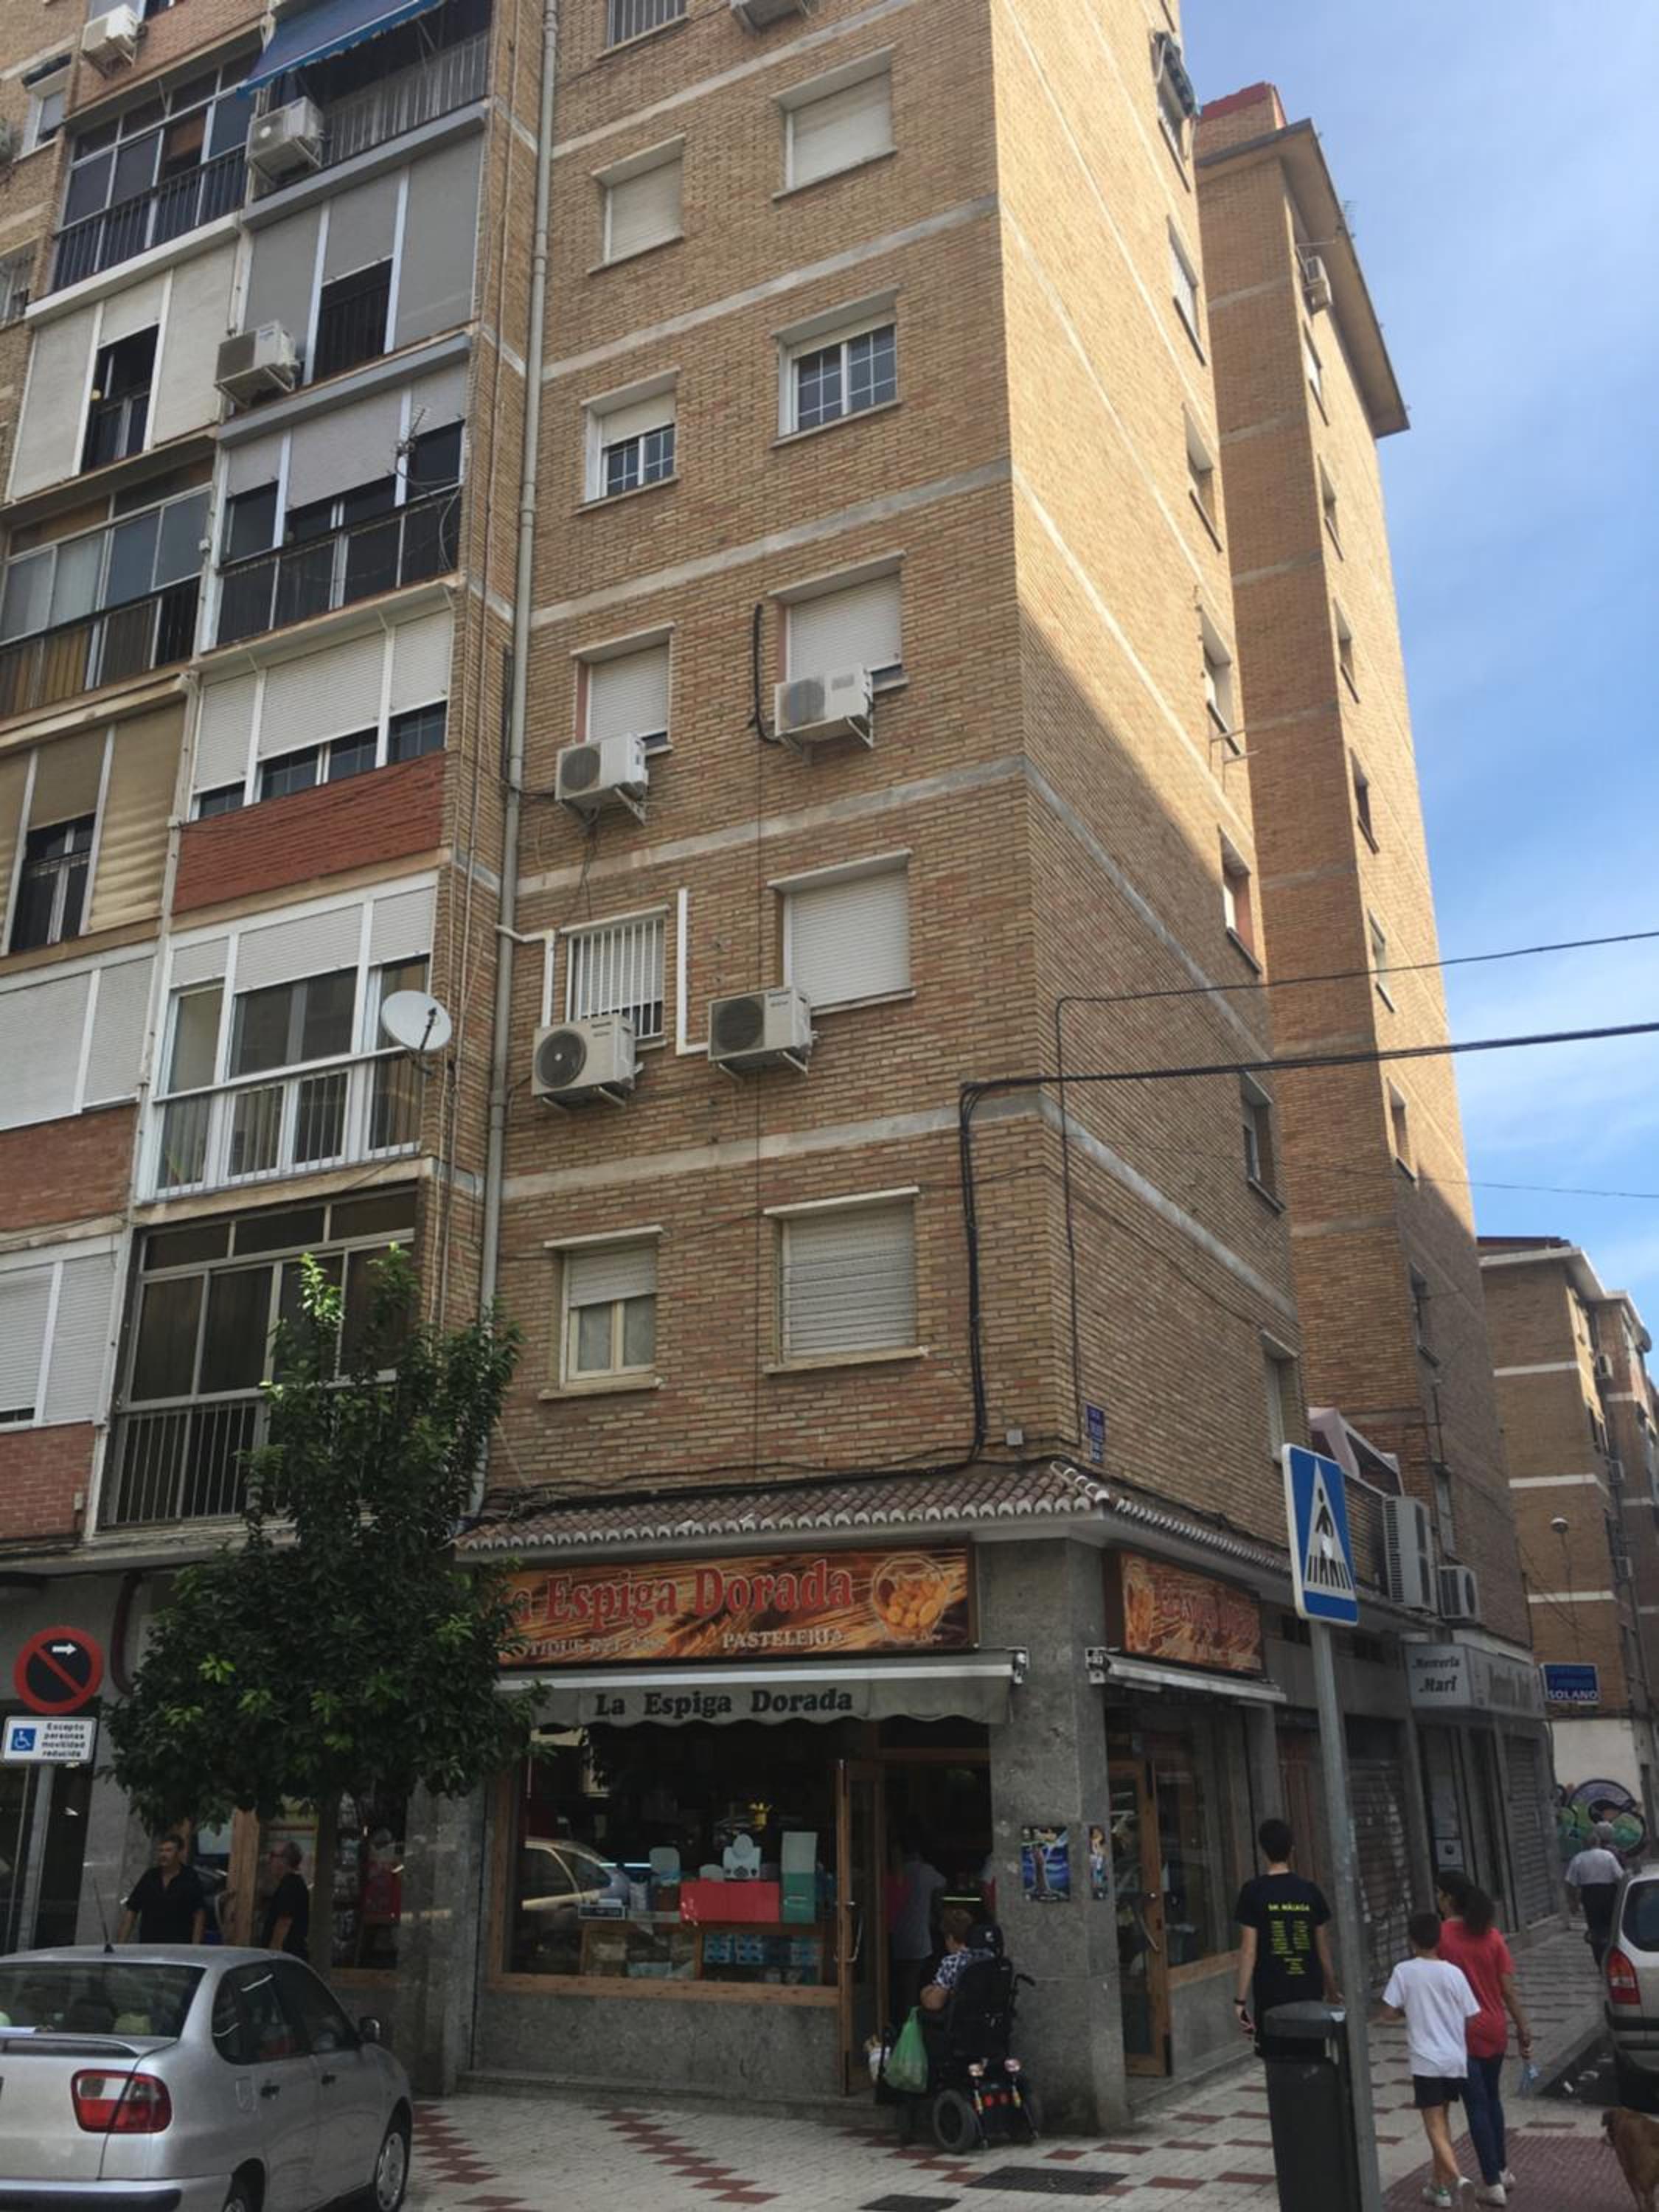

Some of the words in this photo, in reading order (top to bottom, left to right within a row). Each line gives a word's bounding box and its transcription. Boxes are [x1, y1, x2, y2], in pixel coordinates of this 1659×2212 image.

[545, 1570, 677, 1632] Espiga
[695, 1559, 854, 1617] Dorada
[596, 1694, 625, 1716] La
[644, 1688, 733, 1718] Espiga
[751, 1688, 853, 1713] Dorada
[46, 1722, 85, 1732] Excepto
